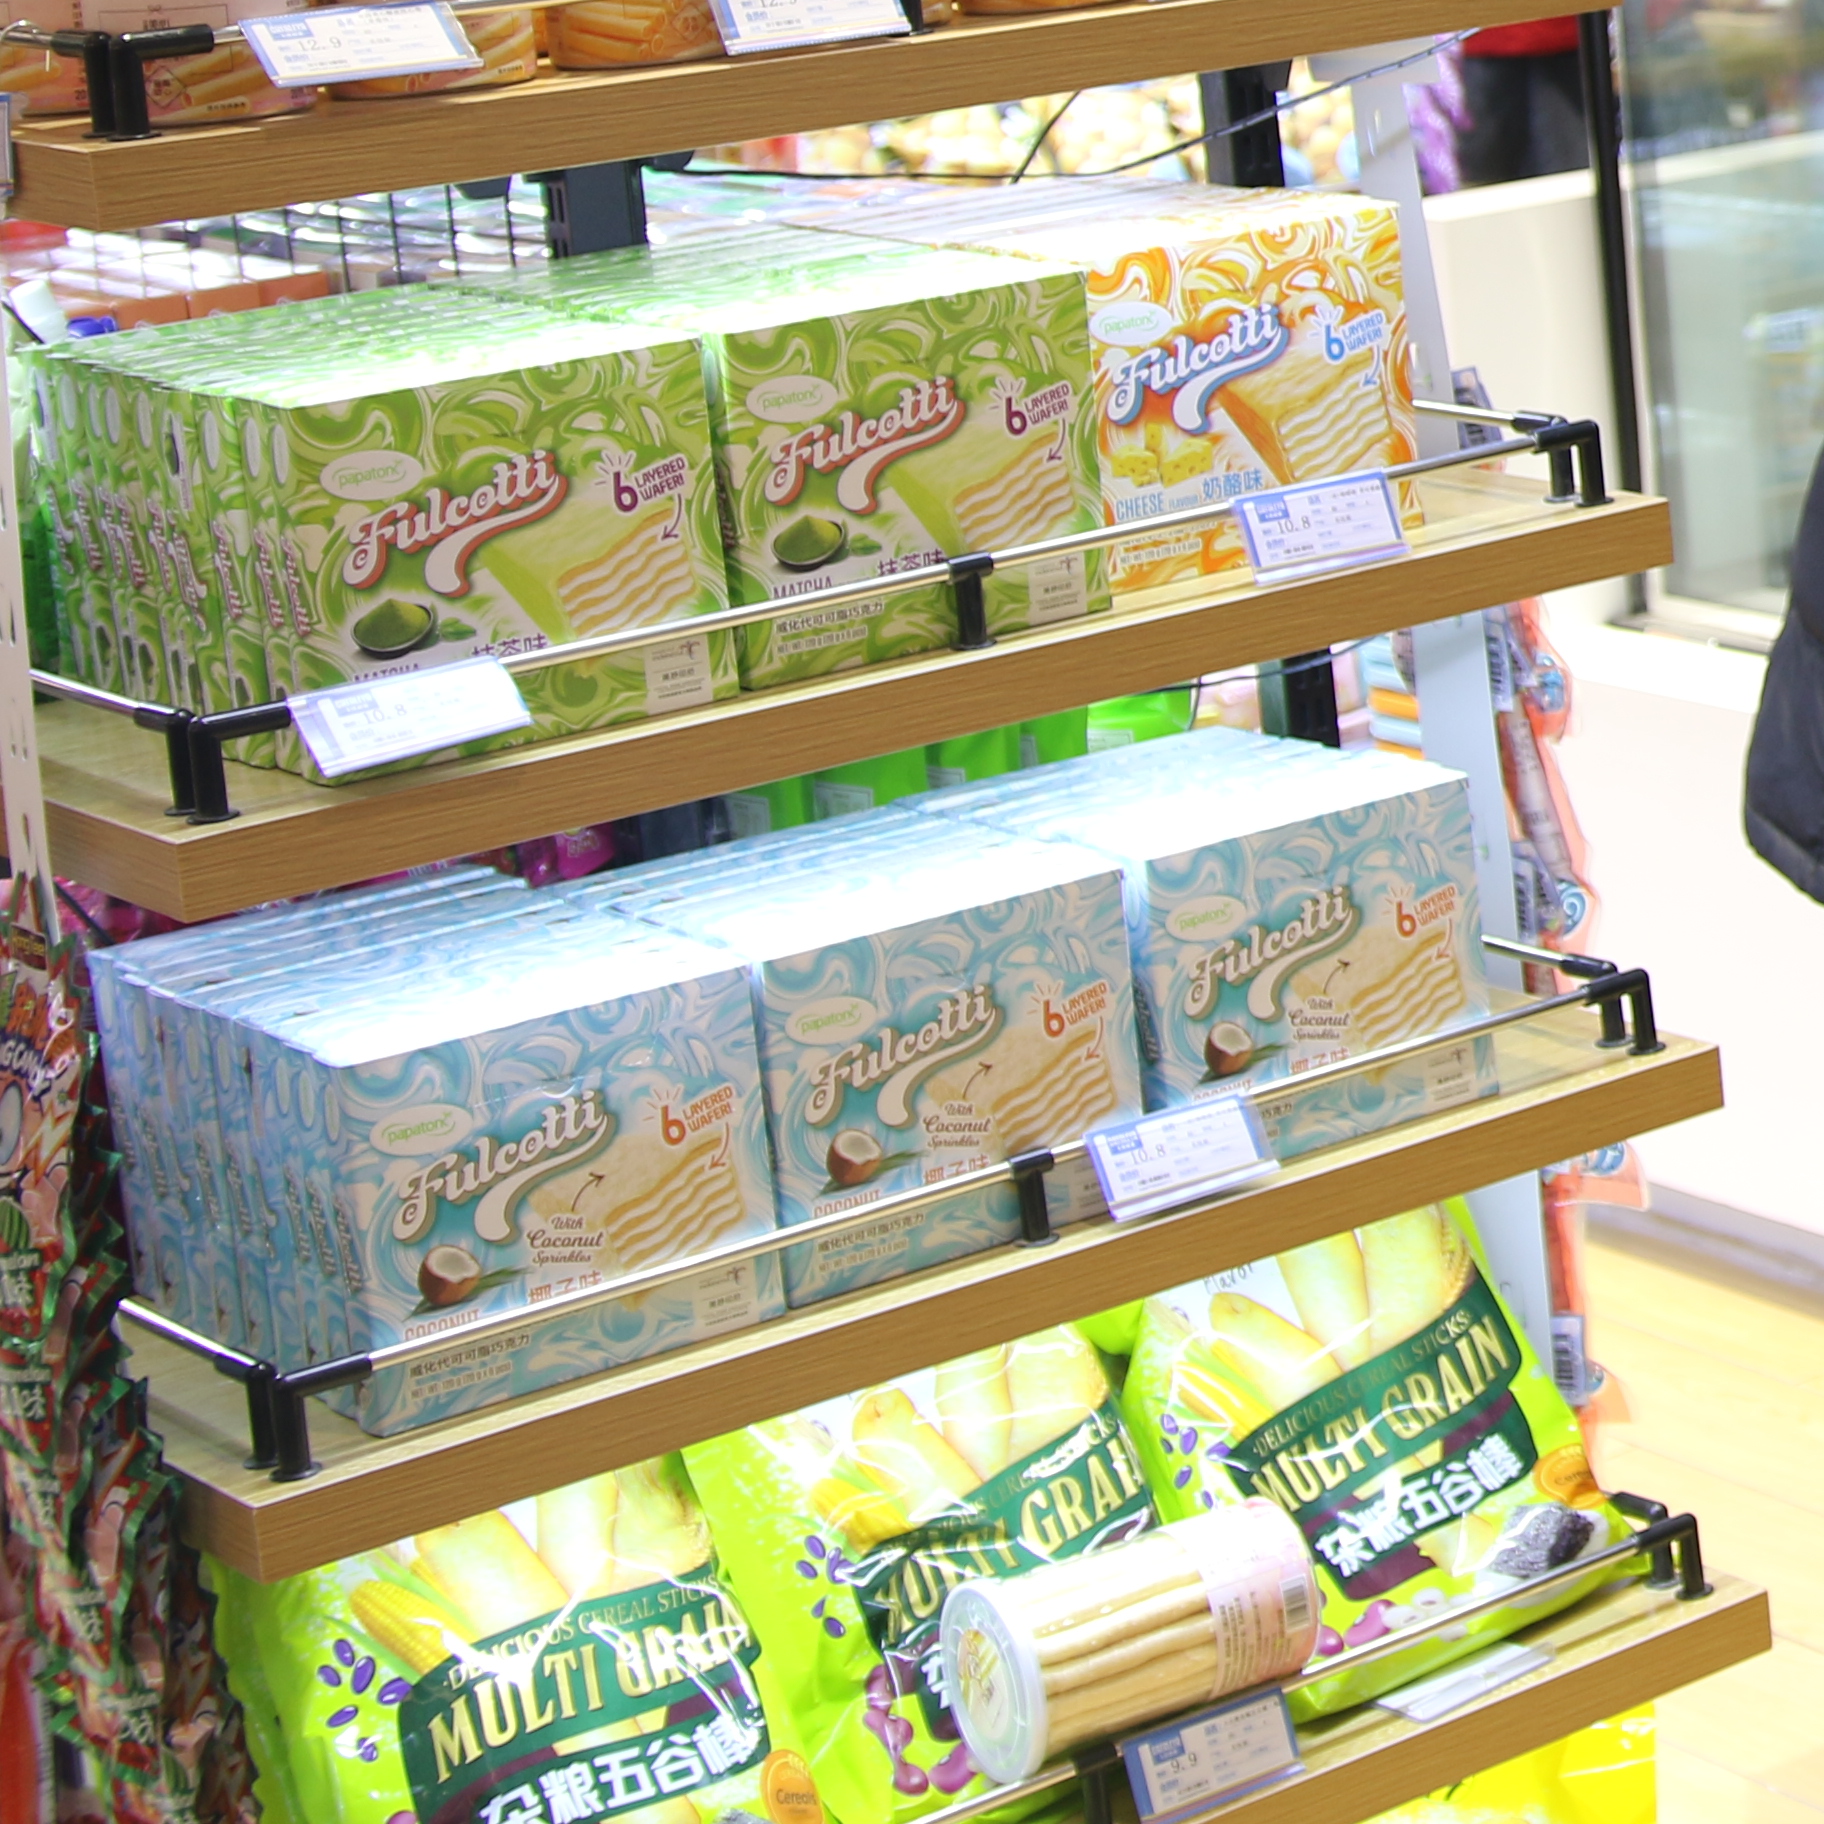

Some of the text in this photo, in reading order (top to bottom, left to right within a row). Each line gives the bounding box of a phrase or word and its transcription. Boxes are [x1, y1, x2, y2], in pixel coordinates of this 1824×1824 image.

[298, 37, 342, 52] 12.9
[1324, 312, 1384, 362] 6 LAYERED
[1345, 327, 1384, 351] WAFER!
[1107, 302, 1290, 434] Fulcotti
[1005, 383, 1070, 436] 6 LAYERED
[1028, 400, 1069, 424] WAFER!
[764, 376, 966, 514] Fulcotti
[613, 456, 686, 512] 6 LAYERED
[638, 473, 686, 501] WAFER!
[1115, 491, 1164, 521] CHEESE
[1202, 469, 1264, 500] 奶酪味
[342, 448, 567, 596] Fulcotti
[1277, 515, 1311, 535] 10.8
[363, 703, 408, 724] 10.8
[1395, 885, 1457, 939] 6 LAYERED
[1417, 901, 1457, 927] WAFER!
[1184, 884, 1362, 1022] Fulcotti
[1042, 981, 1108, 1038] 6 LAYERED
[1065, 998, 1107, 1024] WAFER!
[1288, 1011, 1350, 1027] Coconut
[804, 982, 1007, 1128] Fulcotti
[660, 1085, 735, 1146] 6 LAYERED
[687, 1102, 733, 1132] WAFER!
[922, 1116, 992, 1134] Coconut
[392, 1089, 619, 1243] Fulcotti
[1131, 1143, 1166, 1166] 10.8
[527, 1230, 603, 1250] Coconut
[551, 1215, 585, 1231] With
[532, 1250, 593, 1266] Sprinkles
[1250, 1315, 1512, 1513] MULTI GRAIN
[1315, 1432, 1525, 1578] 杂粮五谷棒
[577, 1596, 655, 1635] CEREAL
[427, 1643, 605, 1784] MULTI
[479, 1712, 765, 1824] 杂粮五谷棒
[1170, 1752, 1198, 1774] 9.9
